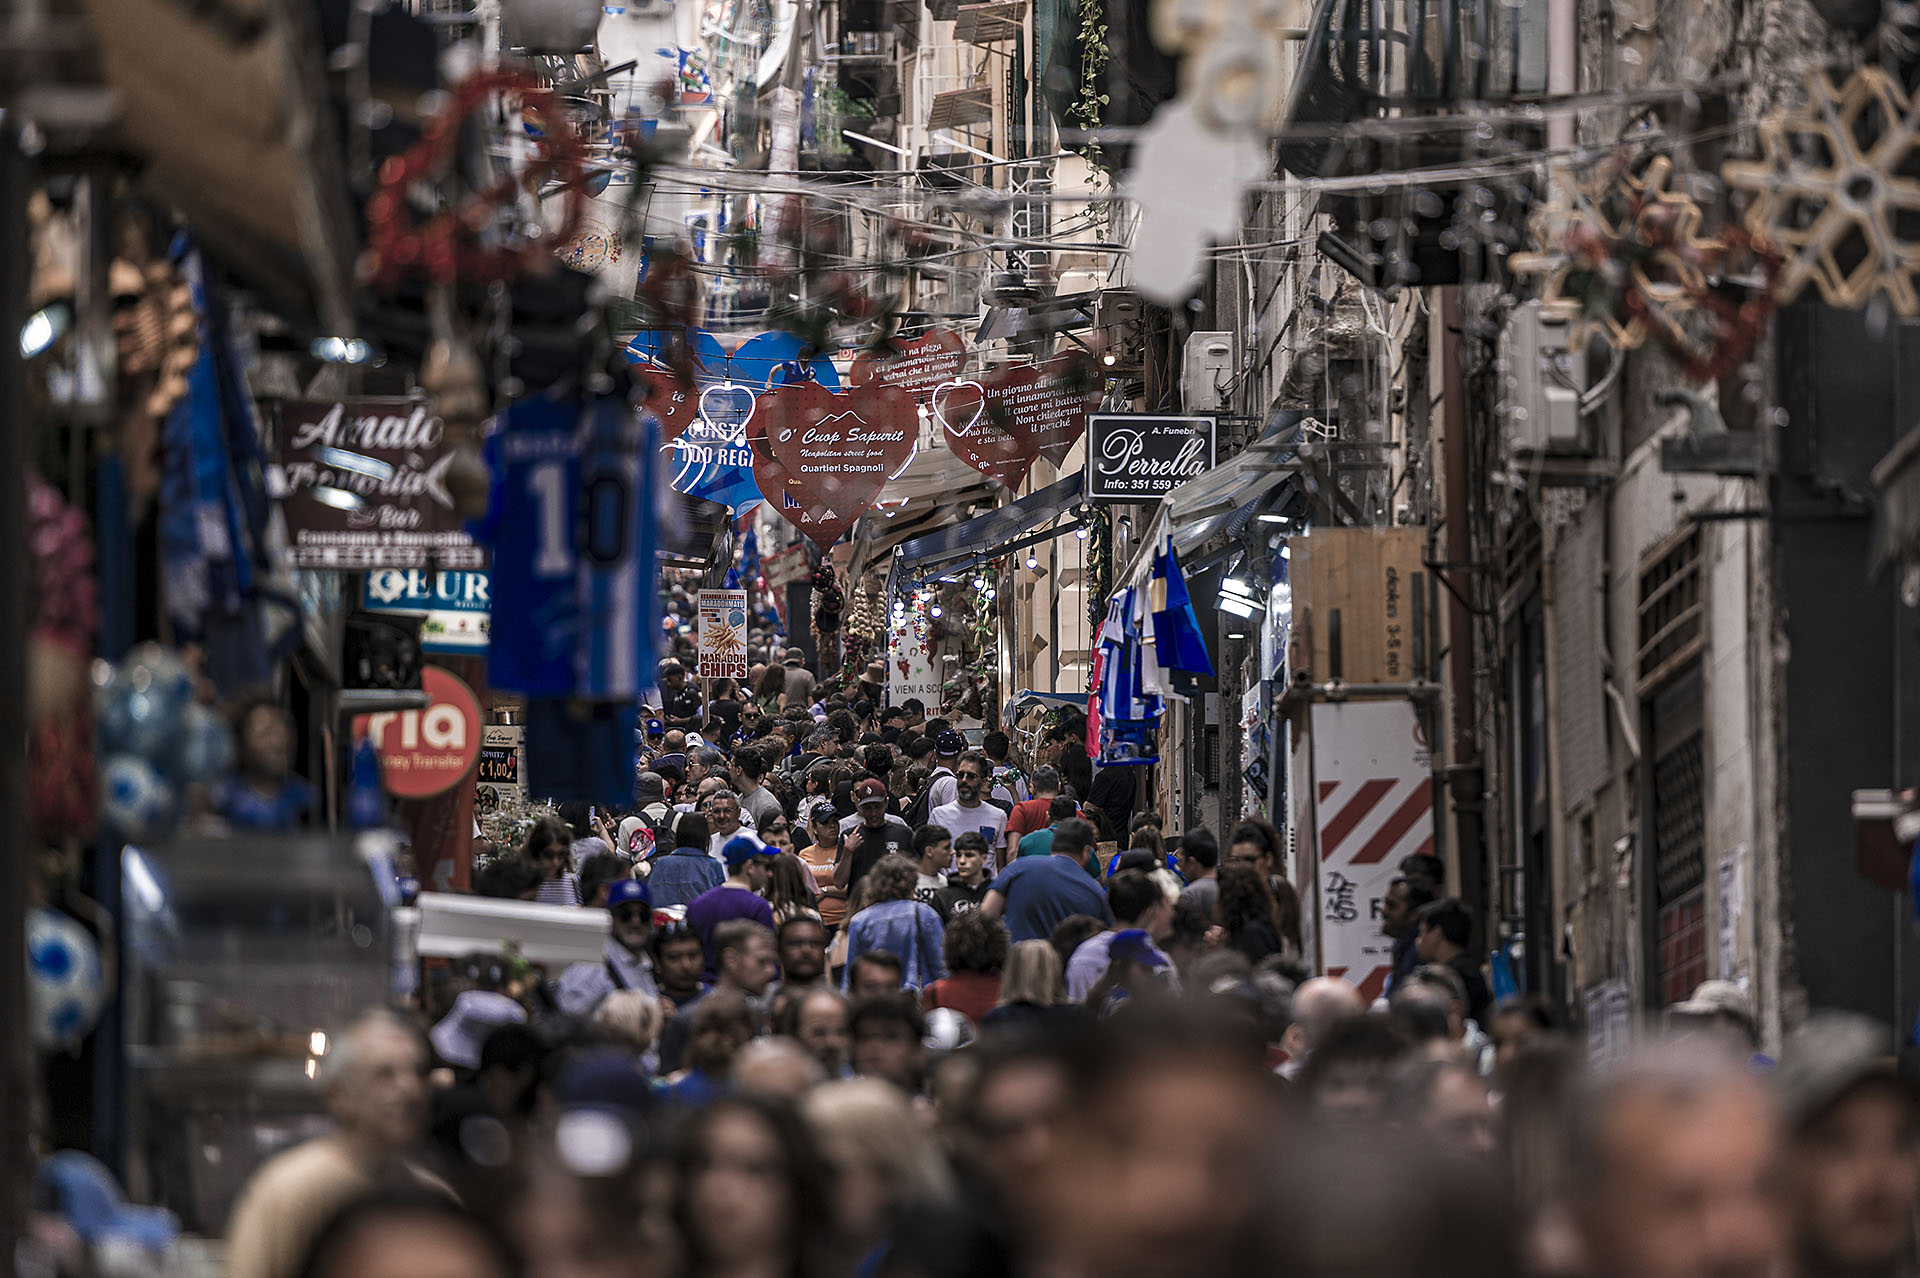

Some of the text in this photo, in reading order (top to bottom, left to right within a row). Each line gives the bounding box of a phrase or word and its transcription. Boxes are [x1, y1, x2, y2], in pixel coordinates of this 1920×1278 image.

[921, 344, 942, 354] pizza
[908, 367, 922, 376] che
[987, 389, 1001, 398] Un
[1002, 384, 1032, 397] giorno
[1003, 396, 1015, 406] mi
[1013, 404, 1039, 415] cuore
[1041, 400, 1053, 409] mi
[1055, 395, 1089, 407] batteva
[1016, 404, 1082, 425] Non chiedermi
[1031, 417, 1071, 433] il perché
[1151, 427, 1196, 435] A. Funebri
[801, 428, 841, 445] Cuop
[846, 428, 904, 444] Sapurit
[800, 449, 842, 458] Neapolitan
[866, 450, 884, 458] food
[1098, 428, 1205, 476] Perrella
[801, 464, 884, 473] Quartieri Spagnoli
[1104, 479, 1128, 489] Info:
[1131, 479, 1149, 489] 351
[1152, 479, 1171, 489] 559
[700, 663, 746, 677] CHIPS
[895, 684, 916, 694] VIENI
[918, 684, 925, 693] A
[479, 760, 507, 779] € 1,00
